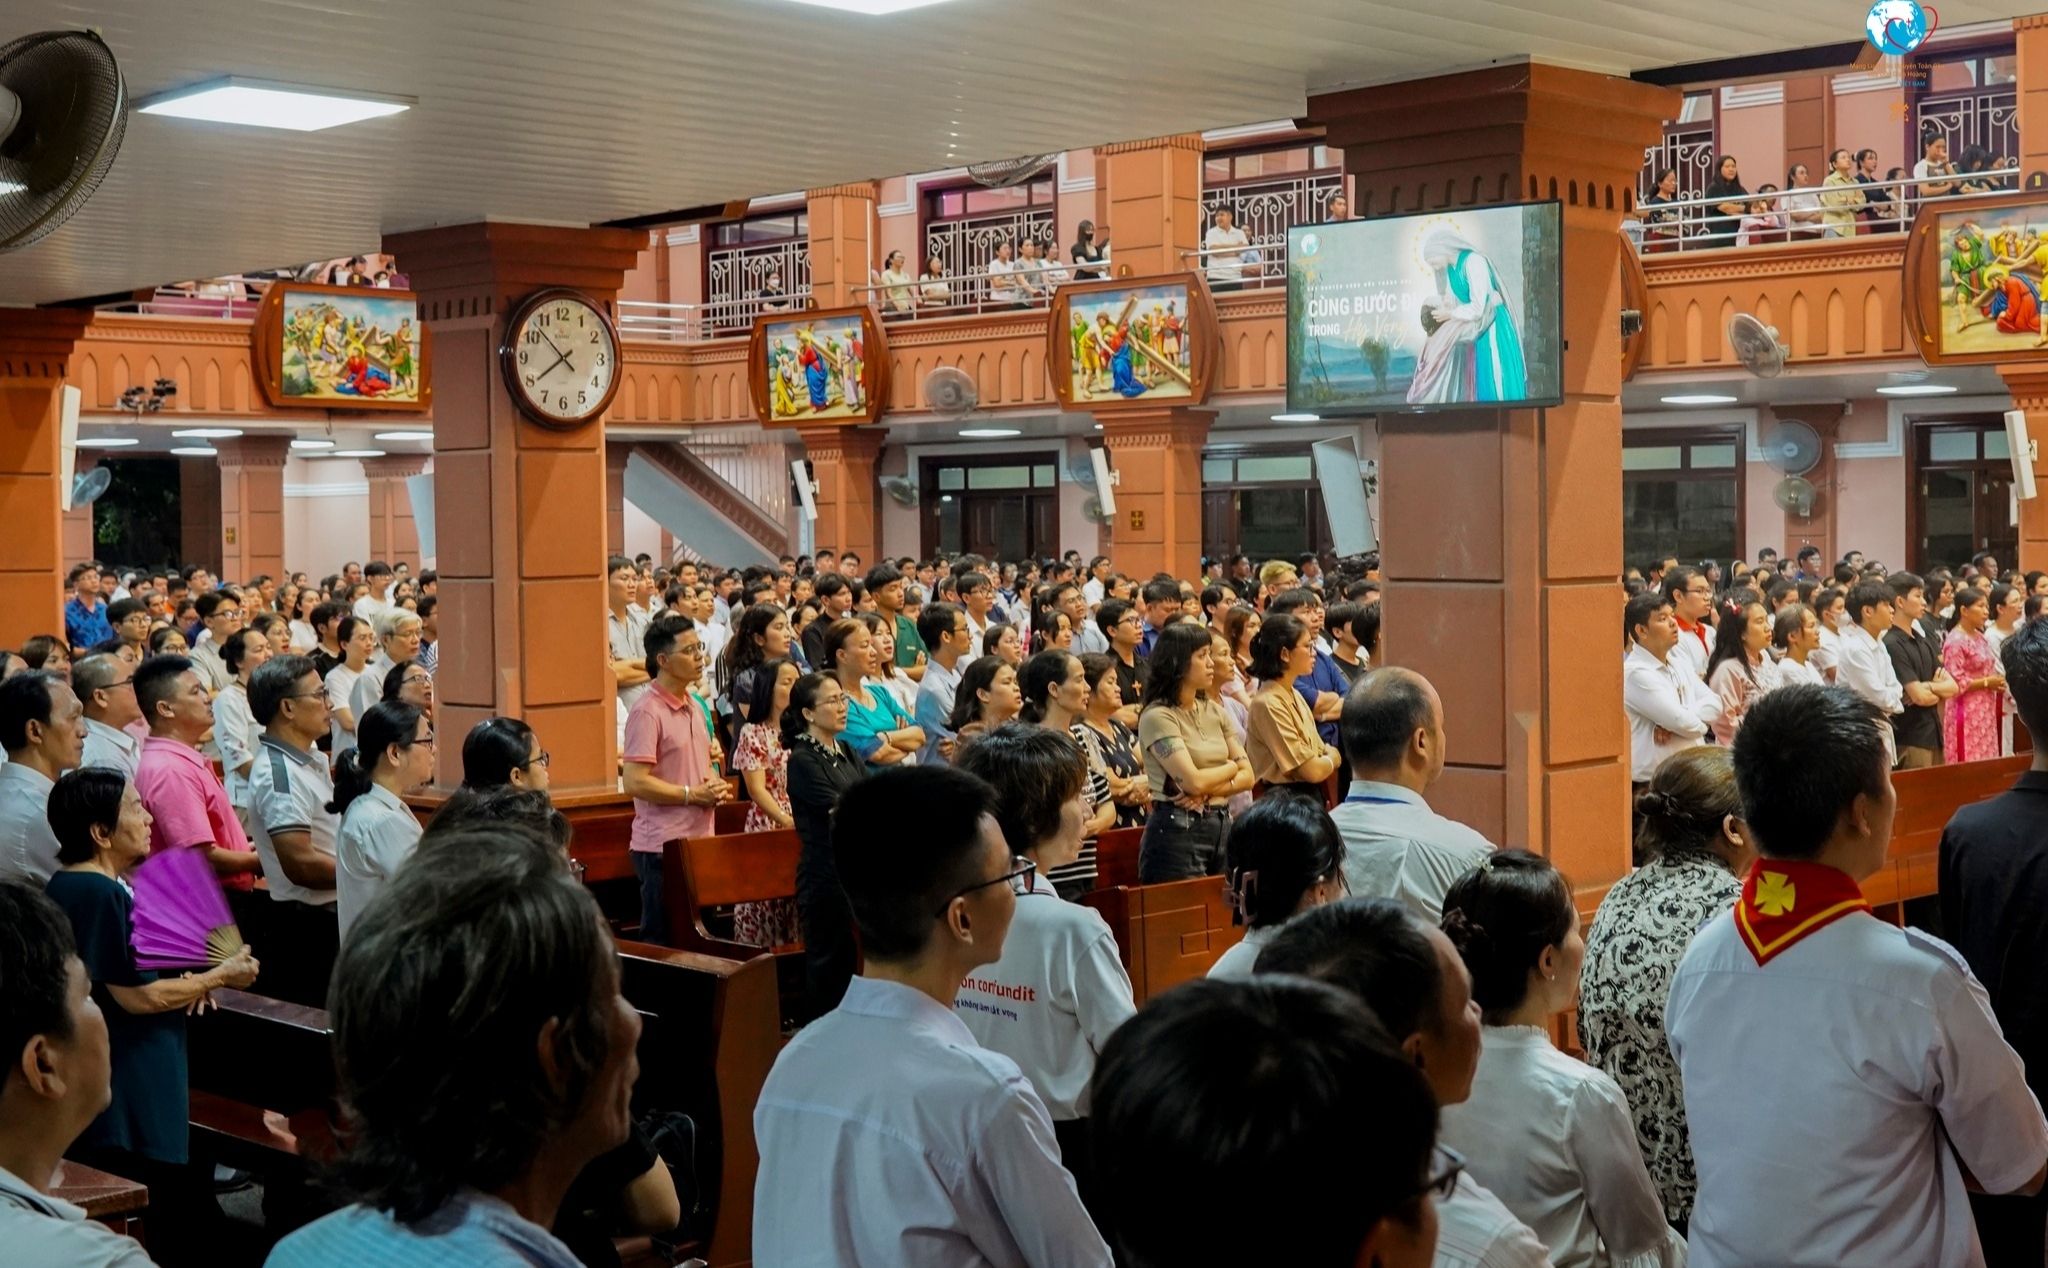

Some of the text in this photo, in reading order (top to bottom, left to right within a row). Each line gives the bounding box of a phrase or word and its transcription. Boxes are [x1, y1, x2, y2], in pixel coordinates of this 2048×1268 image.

[1308, 295, 1350, 317] CÙNG
[1354, 290, 1397, 314] BƯỚC
[537, 313, 550, 327] 11
[555, 307, 570, 321] 12
[578, 315, 585, 328] 1
[590, 330, 599, 344] 2
[1308, 323, 1340, 337] TRONG
[525, 331, 541, 345] 10
[519, 351, 529, 365] 9
[596, 353, 605, 366] 3
[525, 374, 535, 388] 8
[591, 375, 599, 388] 4
[540, 390, 549, 404] 7
[559, 396, 568, 410] 6
[577, 391, 586, 404] 5
[961, 977, 975, 990] on
